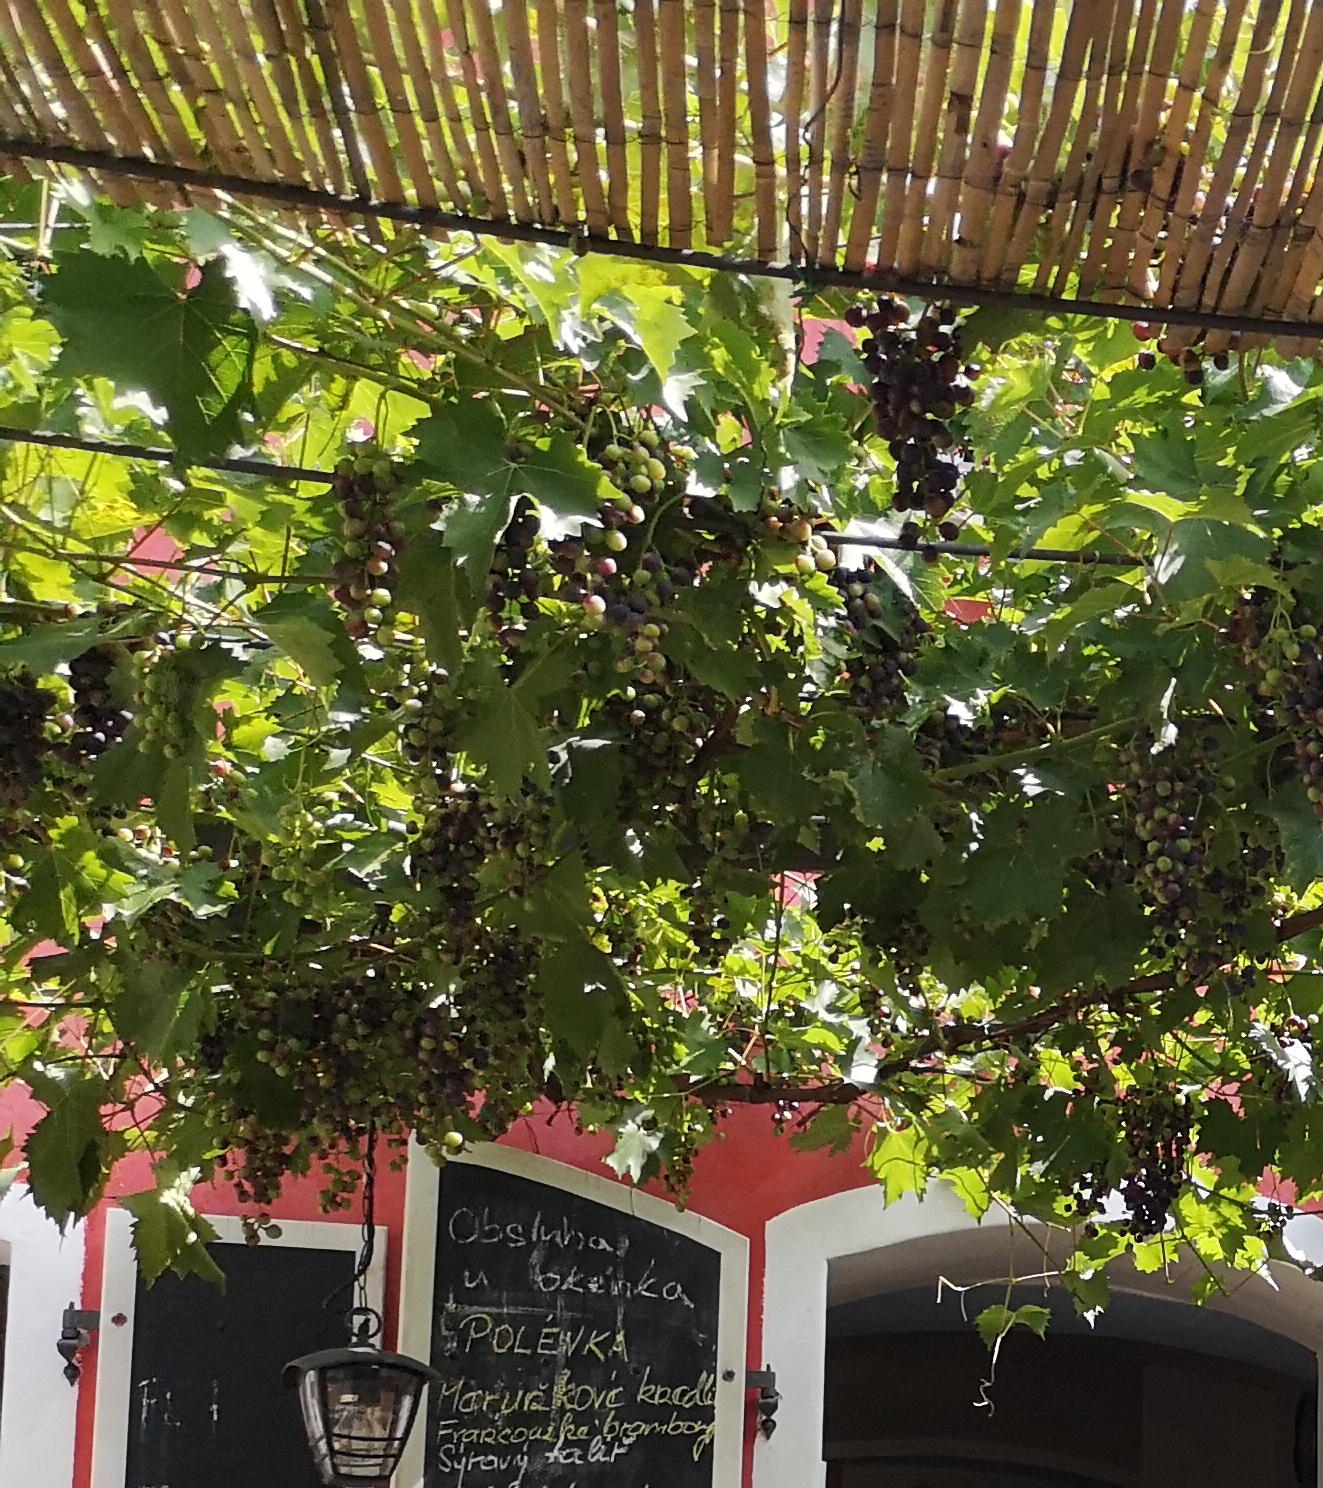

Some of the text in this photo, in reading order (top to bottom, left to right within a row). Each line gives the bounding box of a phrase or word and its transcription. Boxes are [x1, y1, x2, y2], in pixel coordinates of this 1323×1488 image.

[449, 1206, 613, 1252] Obsluha
[464, 1270, 488, 1288] u
[459, 1313, 629, 1362] POLÉVKA
